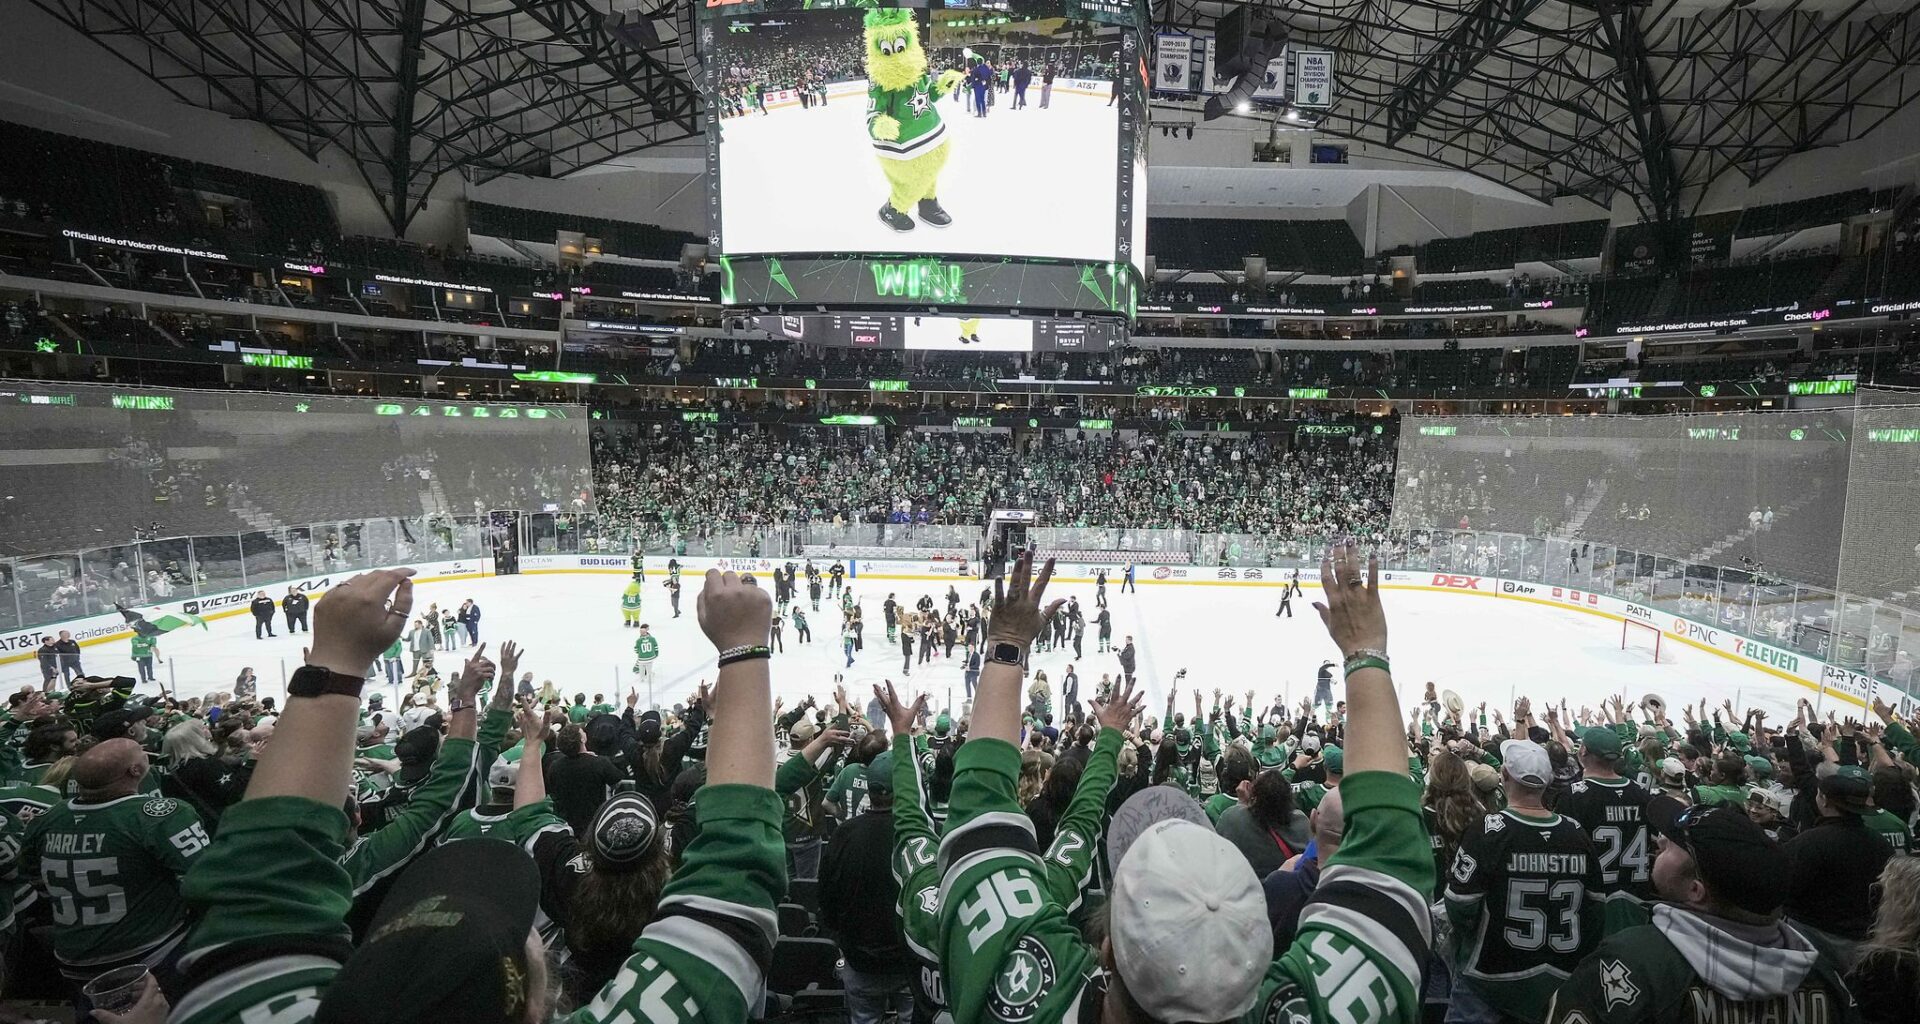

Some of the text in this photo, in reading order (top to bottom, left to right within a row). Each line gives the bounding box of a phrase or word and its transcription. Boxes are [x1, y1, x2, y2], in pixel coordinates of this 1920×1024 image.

[1306, 57, 1323, 66] NBA
[706, 55, 715, 124] TEXAS
[1076, 82, 1098, 90] AT&T
[1122, 62, 1132, 131] TEXAS
[62, 229, 98, 242] Official
[98, 236, 116, 244] ride
[127, 240, 157, 250] Voice?
[157, 245, 184, 254] Gone.
[184, 248, 206, 258] Feet:
[206, 251, 229, 260] Sore.
[873, 264, 960, 297] WIN!
[1784, 309, 1830, 321] Check lyft
[1872, 302, 1904, 313] Official
[1137, 386, 1218, 396] STARS
[601, 558, 627, 566] LIGHT
[1432, 574, 1482, 589] DEX
[201, 591, 256, 608] VICTORY
[1626, 604, 1652, 620] PATH
[75, 623, 126, 641] children's
[1689, 624, 1718, 645] PNC
[0, 632, 43, 651] AT&T
[641, 643, 652, 653] 00
[1830, 681, 1866, 698] ENERGY DRIN
[1605, 805, 1641, 822] HINTZ
[46, 832, 105, 854] HARLEY
[169, 821, 210, 857] 55
[1506, 853, 1587, 874] JOHNSTON
[1592, 824, 1650, 885] 24
[41, 856, 127, 925] 55
[1503, 878, 1585, 953] 53
